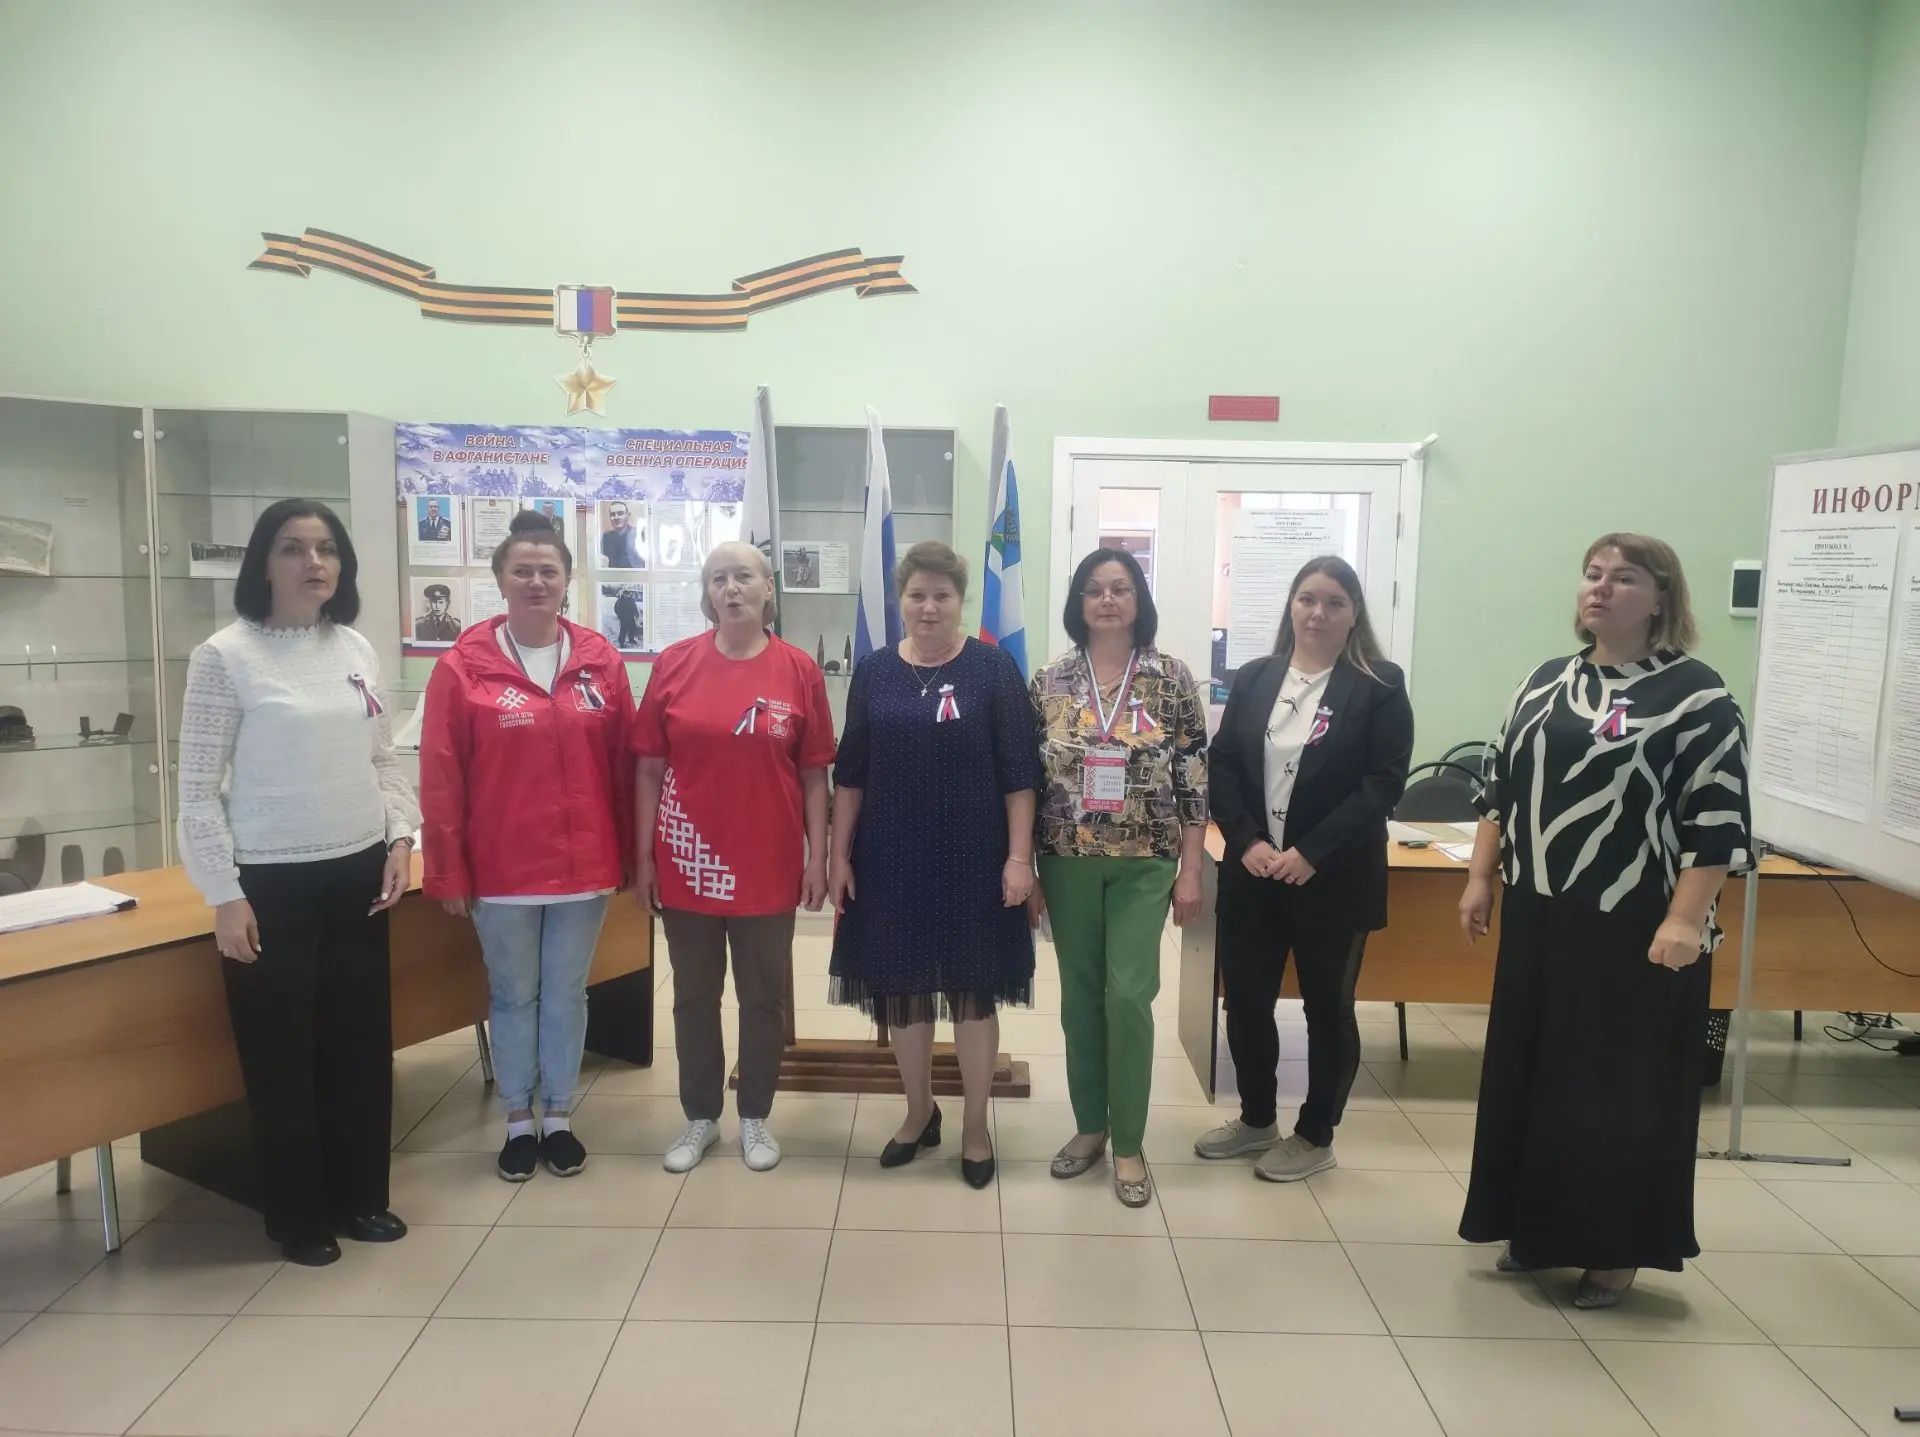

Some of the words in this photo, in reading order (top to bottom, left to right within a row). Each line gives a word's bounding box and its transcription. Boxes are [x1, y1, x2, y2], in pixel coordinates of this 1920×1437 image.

[465, 433, 516, 448] ВОЙНА
[625, 439, 732, 453] СПЕЦИАЛЬНАЯ
[433, 450, 443, 462] В
[445, 450, 549, 464] АФГАНИСТАНЕ
[606, 454, 673, 468] ВОЕННАЯ
